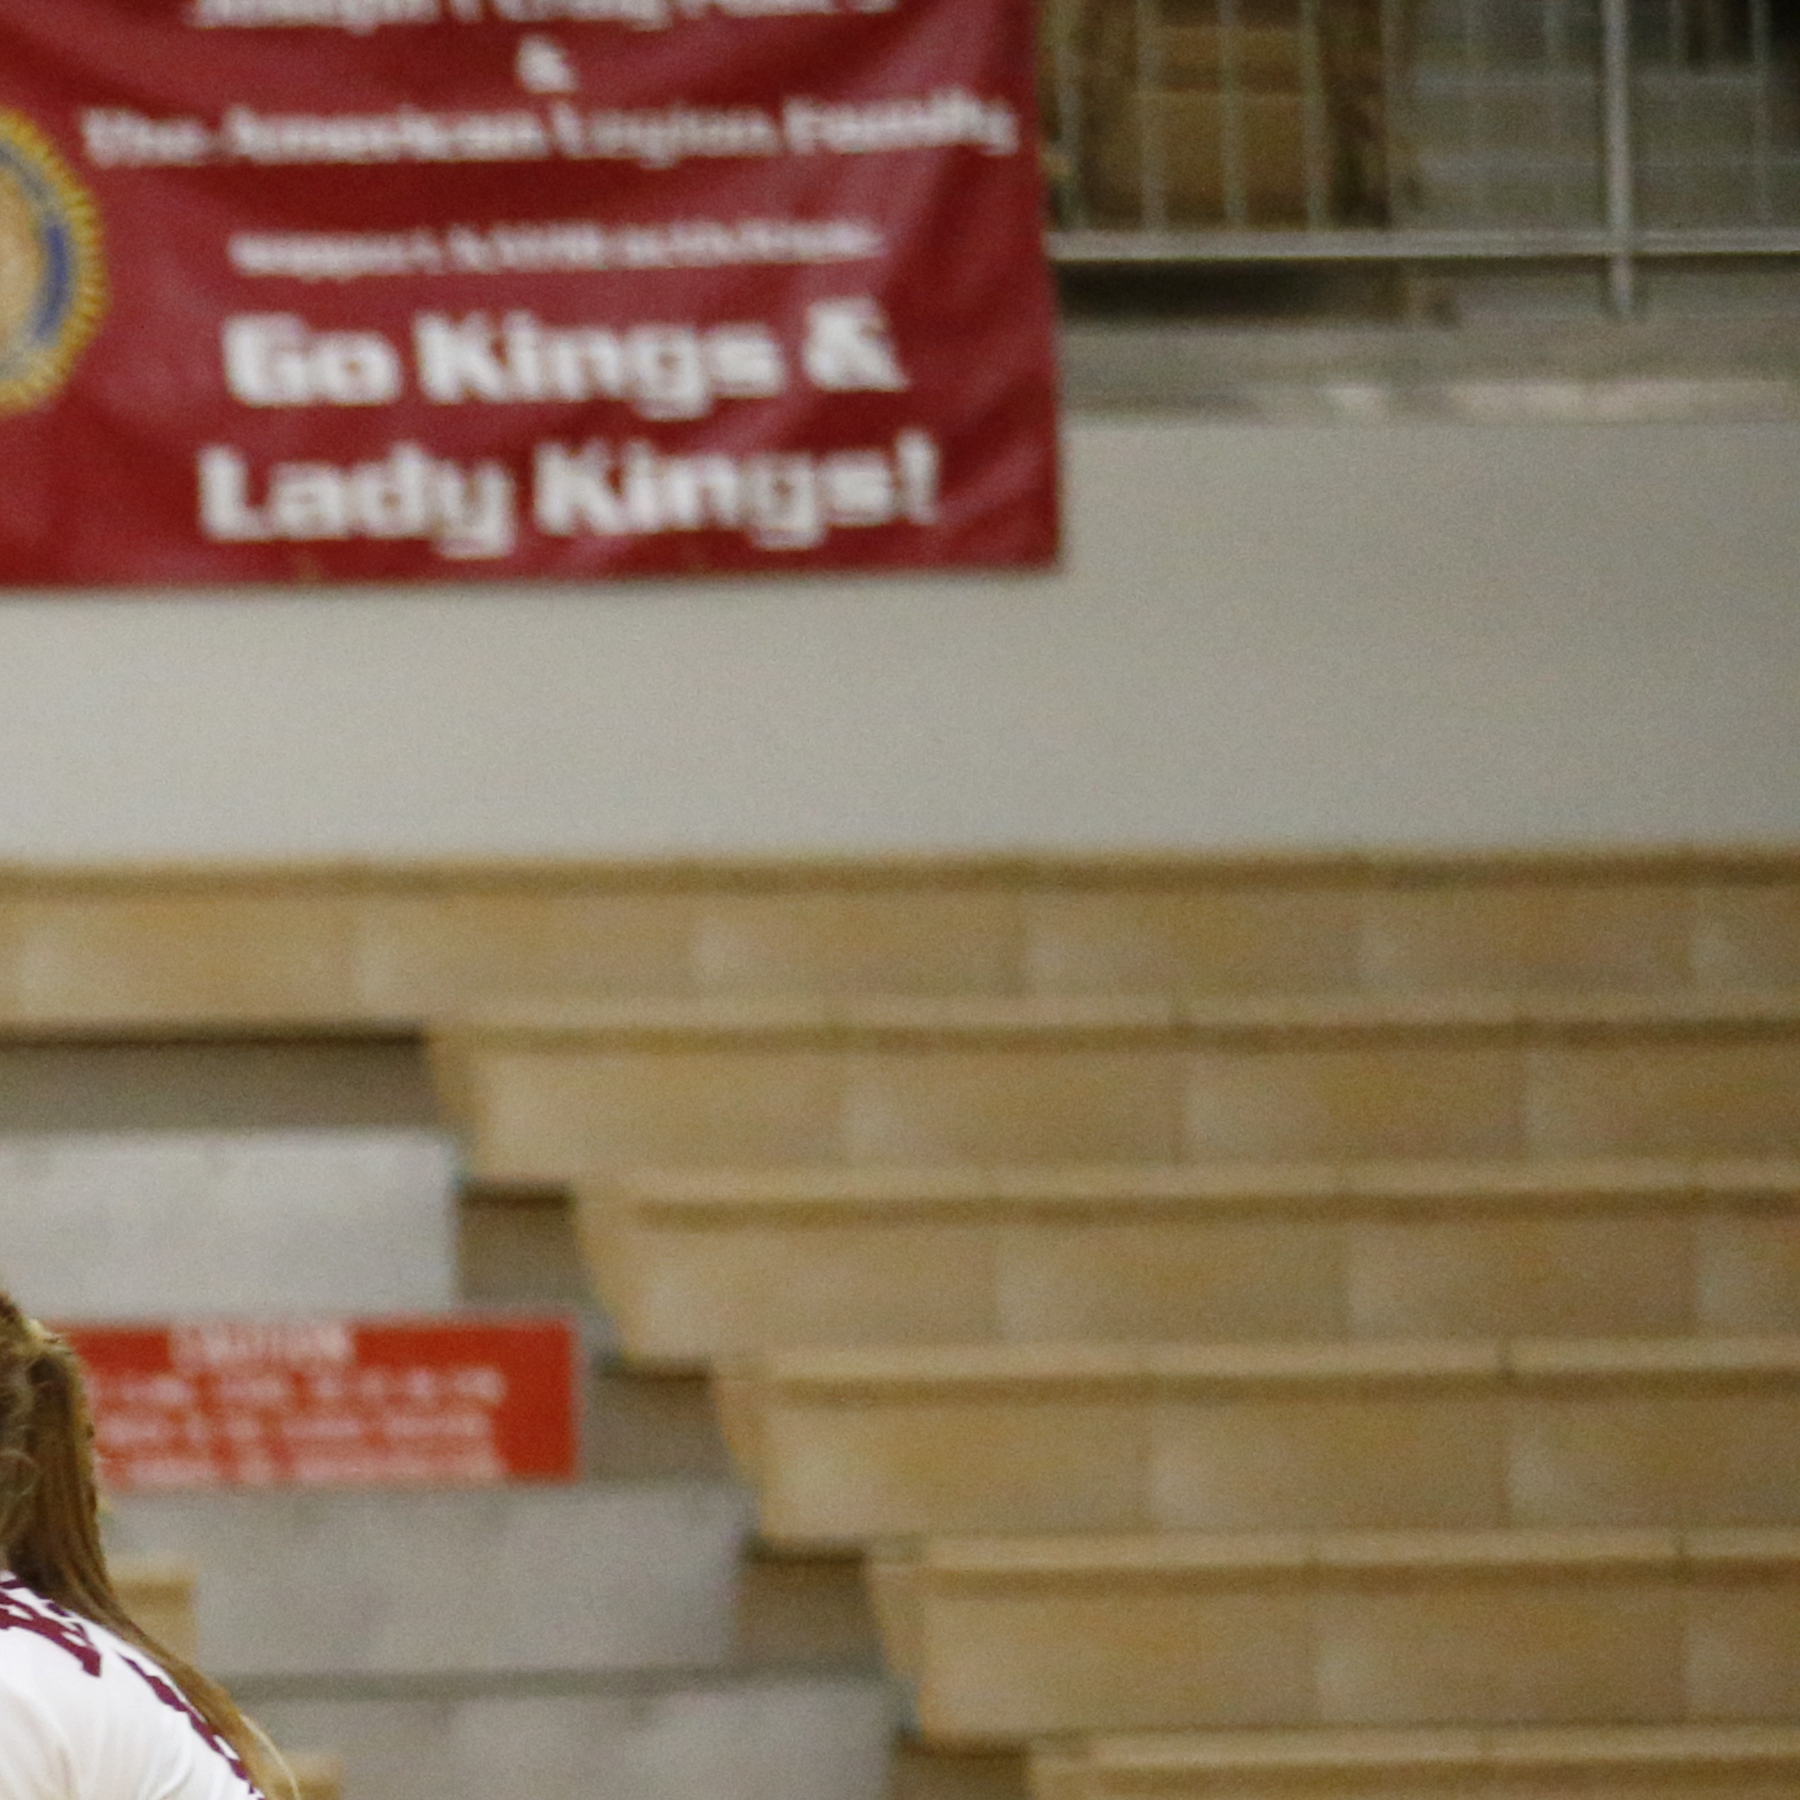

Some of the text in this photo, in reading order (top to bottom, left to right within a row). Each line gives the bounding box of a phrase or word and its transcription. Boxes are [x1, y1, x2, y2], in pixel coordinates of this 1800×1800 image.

[223, 296, 908, 420] Go Kings &
[201, 429, 939, 559] Lady Kings!
